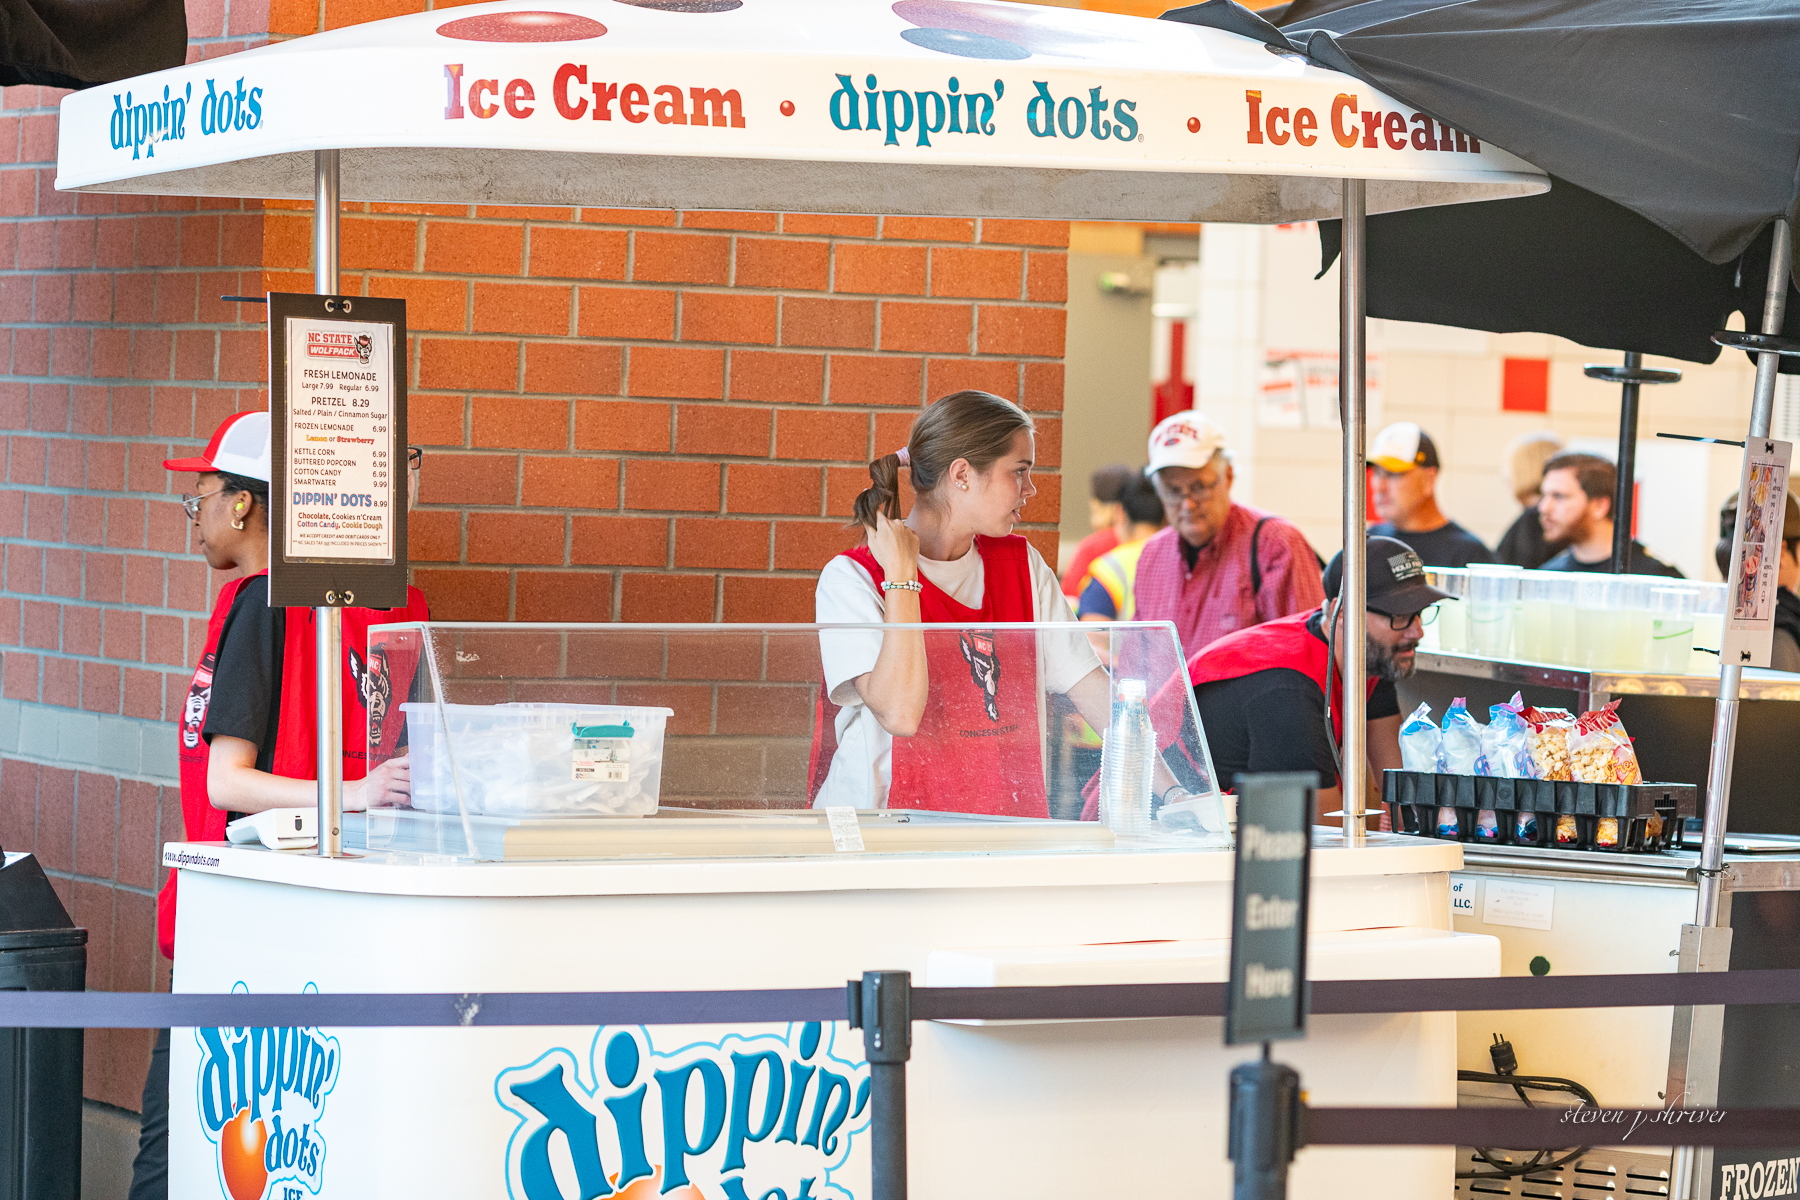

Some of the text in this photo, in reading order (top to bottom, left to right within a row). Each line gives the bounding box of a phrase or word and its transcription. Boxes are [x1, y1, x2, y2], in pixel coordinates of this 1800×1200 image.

[444, 63, 746, 128] Ice Cream
[829, 73, 1138, 147] dippin' dots
[110, 76, 263, 160] dippin' dots
[1246, 90, 1318, 147] Ice
[308, 333, 352, 344] NC STATE
[310, 346, 354, 356] WOLFPACK
[304, 370, 376, 381] FRESH LEMONADE
[302, 382, 318, 390] Large
[340, 384, 362, 392] Regular
[312, 396, 370, 408] PRETZEL 8.29
[338, 410, 369, 418] Cinnamon
[371, 412, 388, 420] Sugar
[320, 424, 354, 432] LEMONADE
[336, 436, 374, 445] Strawberry
[293, 492, 338, 506] DIPPIN'
[341, 494, 372, 507] DOTS
[298, 512, 330, 520] Chocolate,
[319, 521, 340, 530] Candy,
[364, 522, 383, 531] Dough
[1241, 823, 1306, 861] Please
[1453, 883, 1464, 892] of
[1454, 898, 1472, 909] LLC.
[1246, 893, 1298, 931] Enter
[510, 1021, 871, 1200] dippin'
[266, 1115, 320, 1177] dots
[1720, 1157, 1800, 1200] FROZEN
